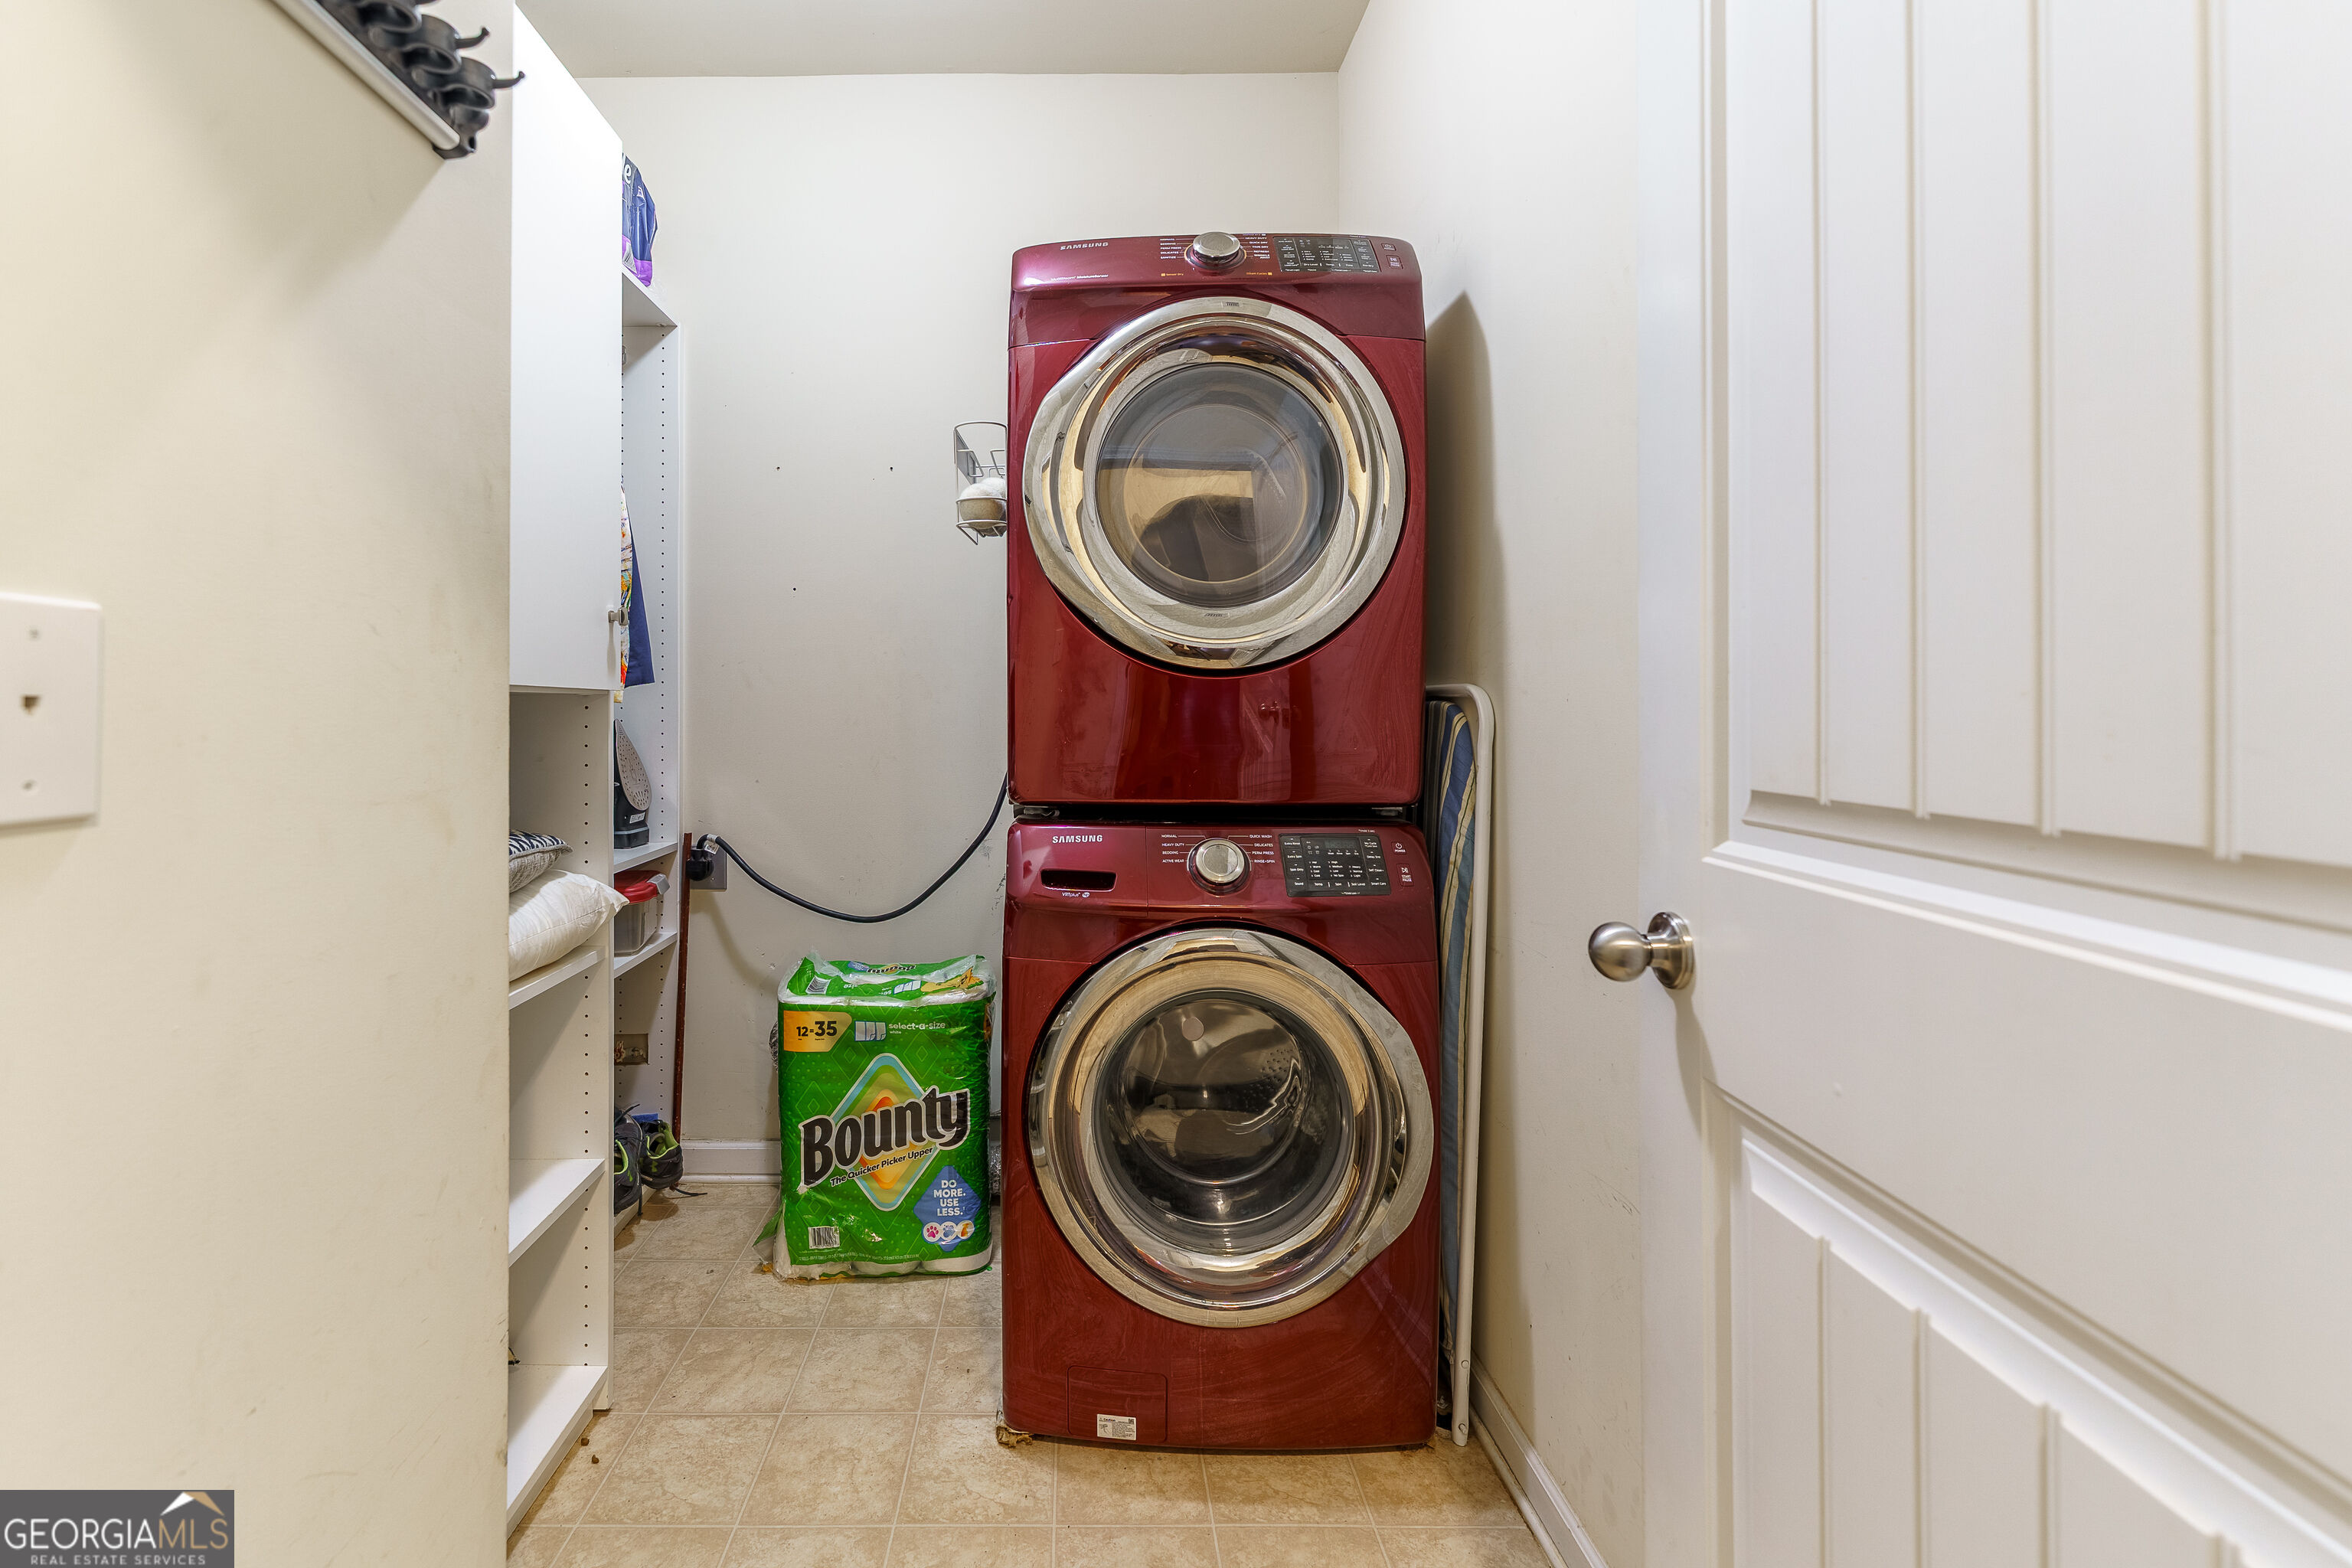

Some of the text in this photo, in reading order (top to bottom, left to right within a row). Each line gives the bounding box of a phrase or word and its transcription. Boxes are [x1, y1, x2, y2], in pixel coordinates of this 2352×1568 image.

[1060, 242, 1109, 250] SAMSUNG
[1052, 835, 1103, 844] SAMSUNG
[888, 1021, 946, 1031] select-a-size
[800, 1086, 970, 1187] Bounty
[830, 1147, 933, 1187] The Quicker Picker Upper
[941, 1179, 957, 1188] DO
[933, 1188, 966, 1198] MORE.
[939, 1198, 959, 1207] USE
